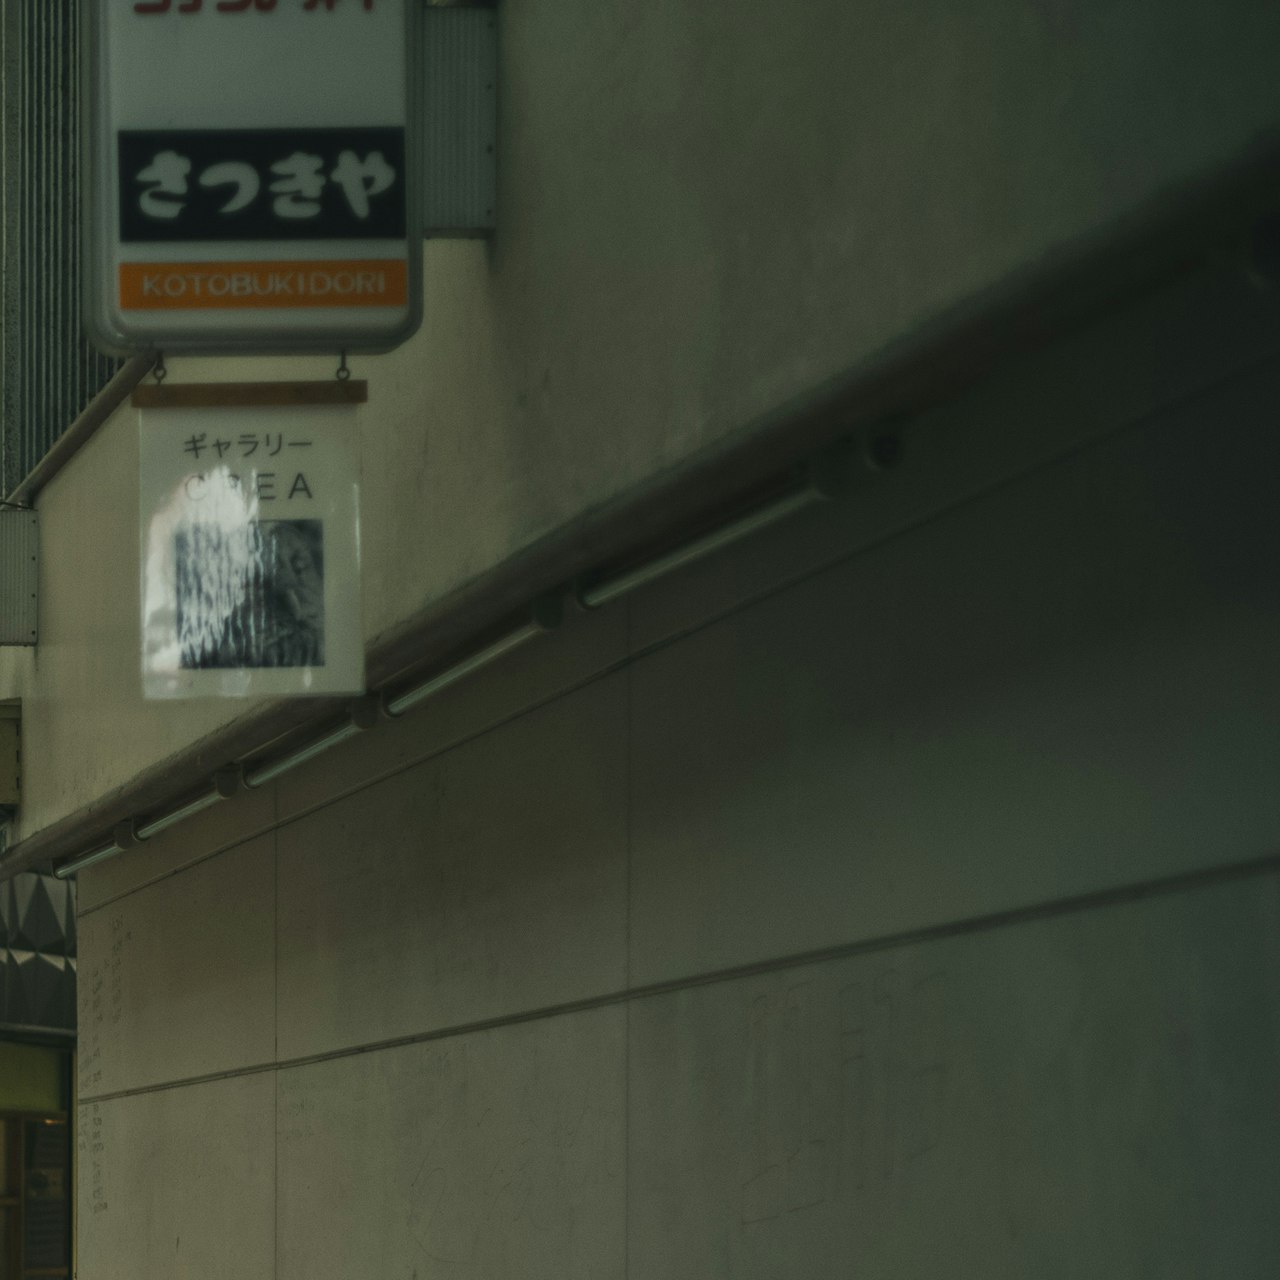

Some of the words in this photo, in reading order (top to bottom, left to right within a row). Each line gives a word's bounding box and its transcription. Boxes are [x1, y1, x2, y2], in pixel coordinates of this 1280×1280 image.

[136, 150, 395, 219] さつきや
[142, 270, 386, 298] KOTOBUKIDORI
[183, 432, 313, 459] ギャラリー
